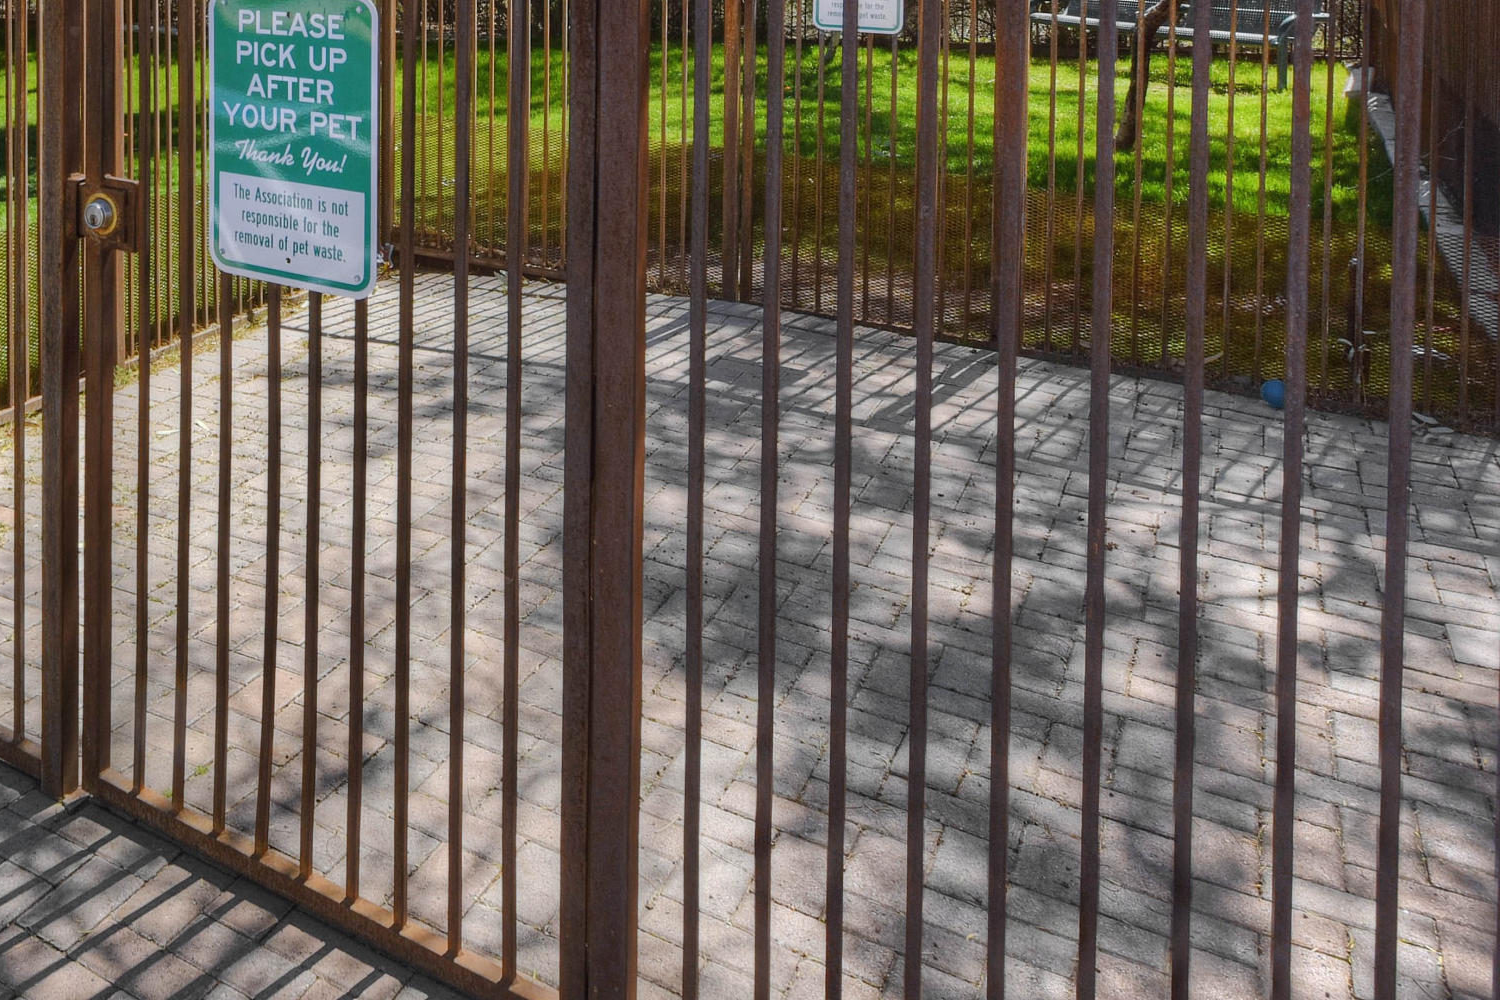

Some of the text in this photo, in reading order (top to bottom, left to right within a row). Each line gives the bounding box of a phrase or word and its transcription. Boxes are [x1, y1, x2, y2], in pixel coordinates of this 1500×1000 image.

[238, 9, 344, 40] PLEASE
[236, 40, 348, 73] PICK UP
[246, 73, 334, 105] AFTER
[222, 101, 362, 140] YOUR PET
[235, 138, 347, 176] Thank You!
[233, 183, 349, 216] The Association is not
[241, 210, 340, 238] responsible for the
[234, 230, 346, 263] removal of pet waste.
